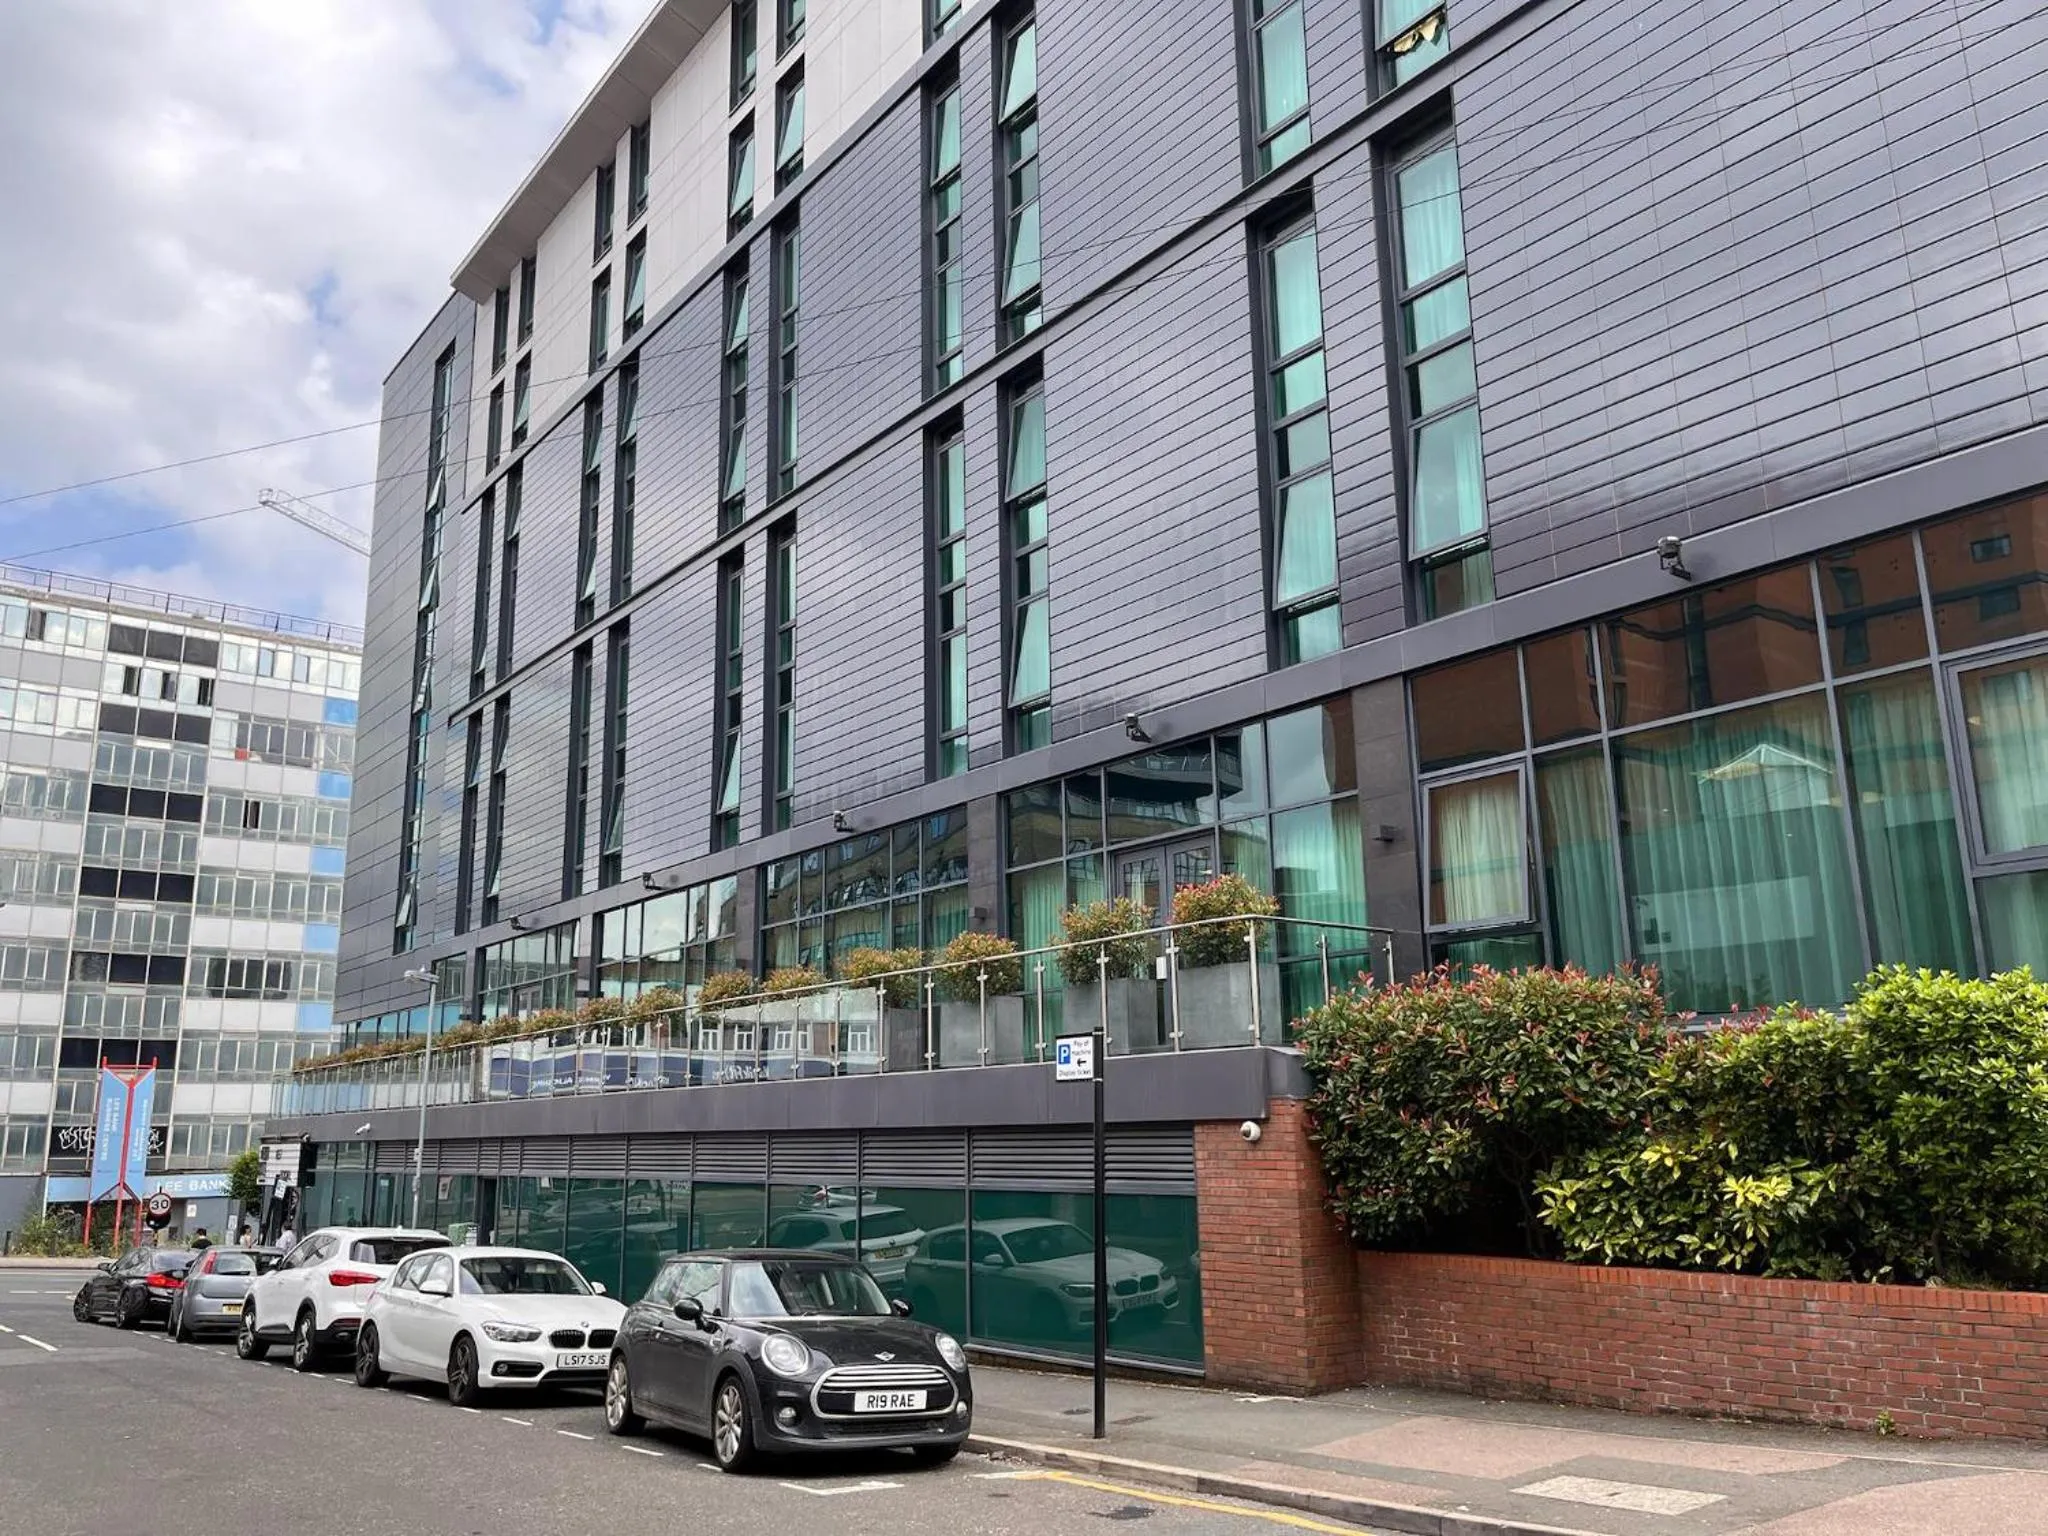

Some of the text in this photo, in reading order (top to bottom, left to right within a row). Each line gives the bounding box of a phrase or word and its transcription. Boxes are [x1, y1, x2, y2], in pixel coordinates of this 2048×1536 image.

[157, 1180, 229, 1193] LEE BANK
[151, 1200, 169, 1210] 30
[564, 1354, 606, 1365] LS17 SJS
[867, 1393, 915, 1408] R19 RAE
